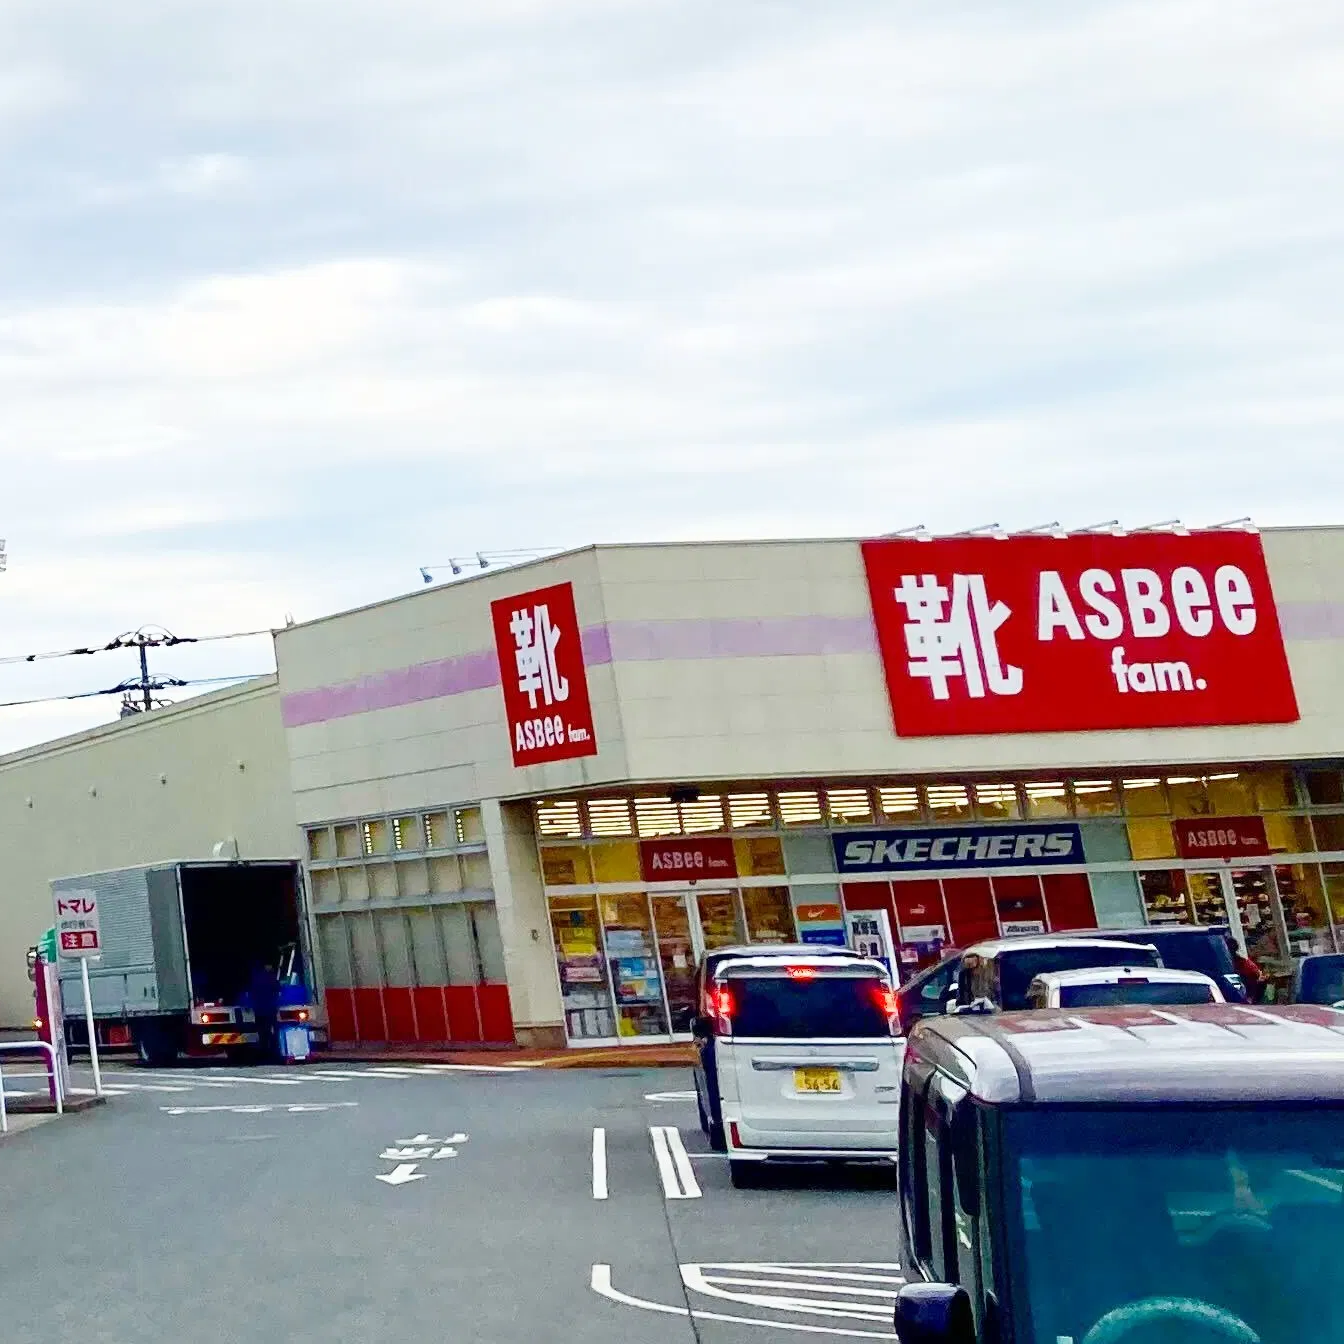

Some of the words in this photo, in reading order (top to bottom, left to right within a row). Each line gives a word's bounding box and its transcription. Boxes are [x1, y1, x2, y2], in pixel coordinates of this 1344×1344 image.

[1037, 564, 1257, 641] ASBee
[510, 605, 569, 709] 靴
[894, 572, 1023, 700] 靴
[1111, 646, 1208, 693] fam.
[515, 715, 565, 752] ASBee
[843, 832, 1074, 865] SKECHERS
[58, 898, 95, 915] トマレ
